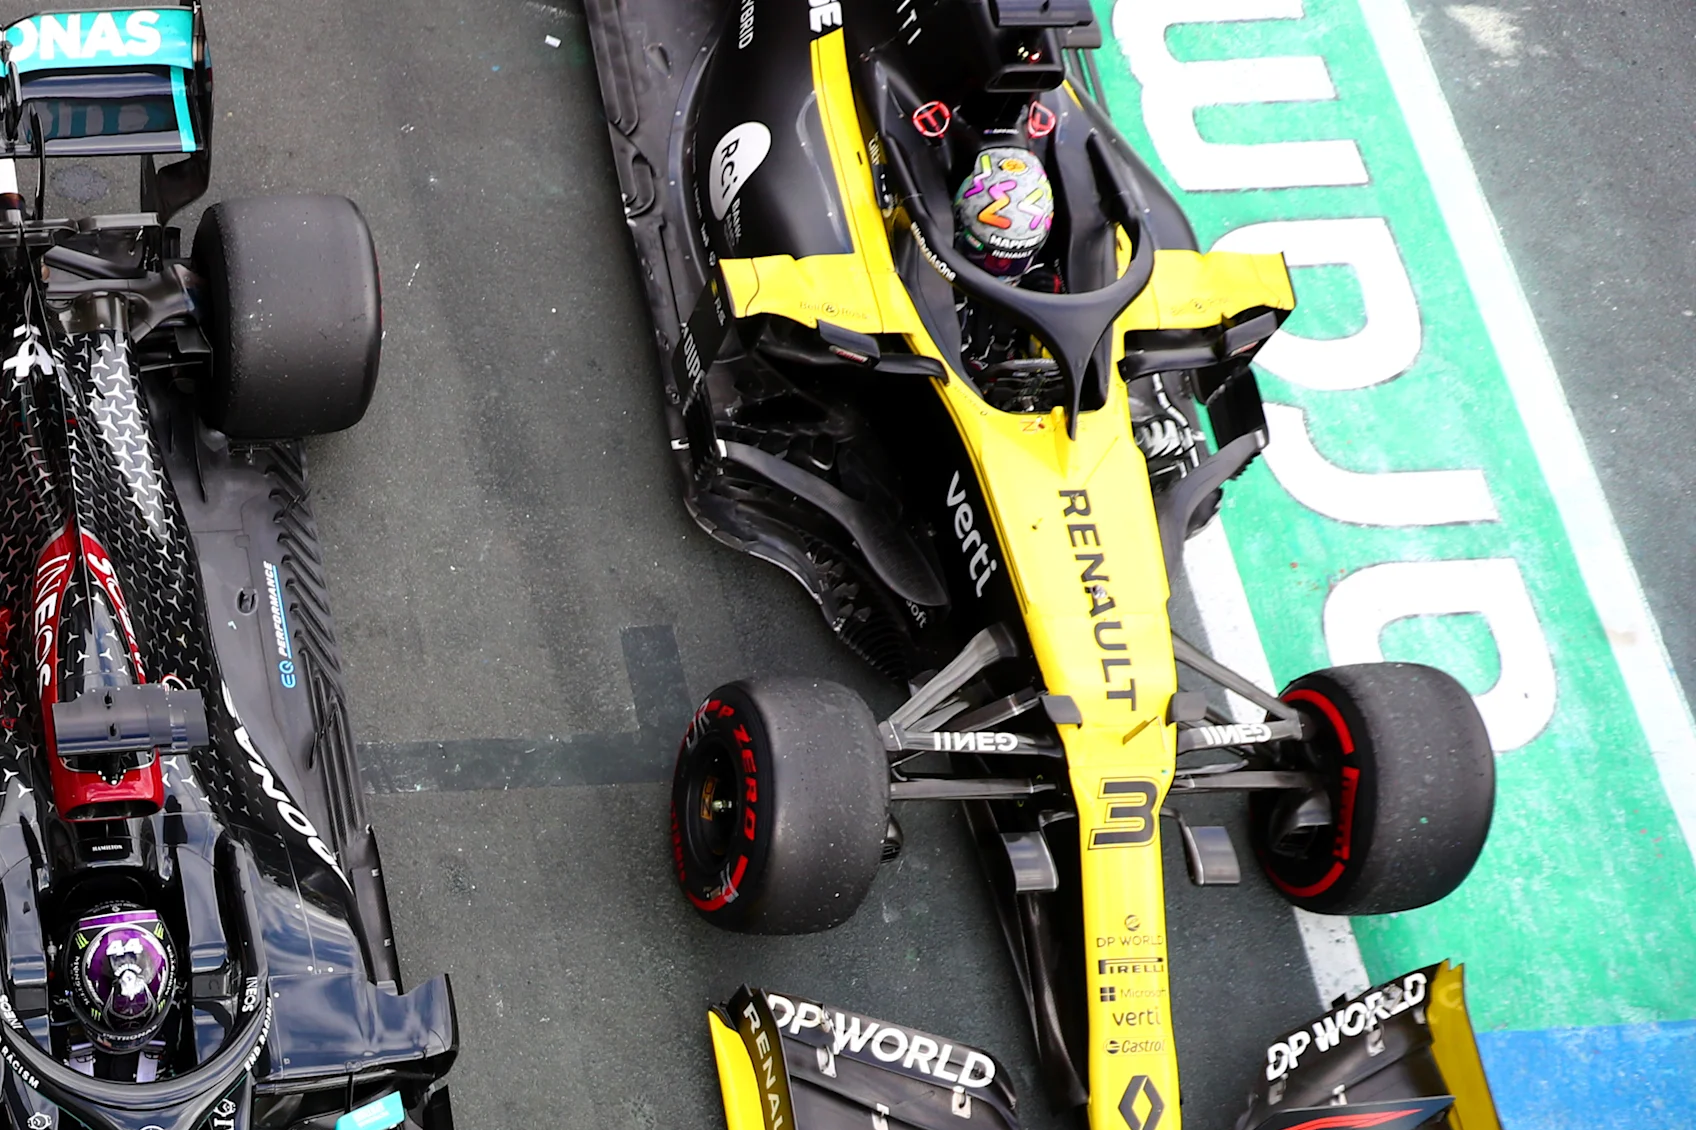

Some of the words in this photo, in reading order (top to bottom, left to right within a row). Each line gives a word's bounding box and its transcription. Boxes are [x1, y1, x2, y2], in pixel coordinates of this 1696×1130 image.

[946, 470, 998, 598] verti
[262, 561, 287, 657] PERFORMANCE
[1058, 489, 1137, 711] RENAULT
[733, 724, 758, 841] ZERO
[1088, 776, 1161, 851] 3
[105, 937, 144, 957] 44
[1096, 937, 1115, 948] DP
[1119, 934, 1164, 947] WORLD
[1098, 956, 1165, 975] PIRELLI
[241, 975, 259, 1013] INEOS
[1112, 1006, 1162, 1027] verti
[768, 994, 828, 1035] DP
[831, 1012, 996, 1088] WORLD
[1121, 1038, 1166, 1054] Castrol
[1266, 1030, 1310, 1081] DP
[1312, 972, 1427, 1053] WORLD
[2, 1046, 40, 1089] RACISM
